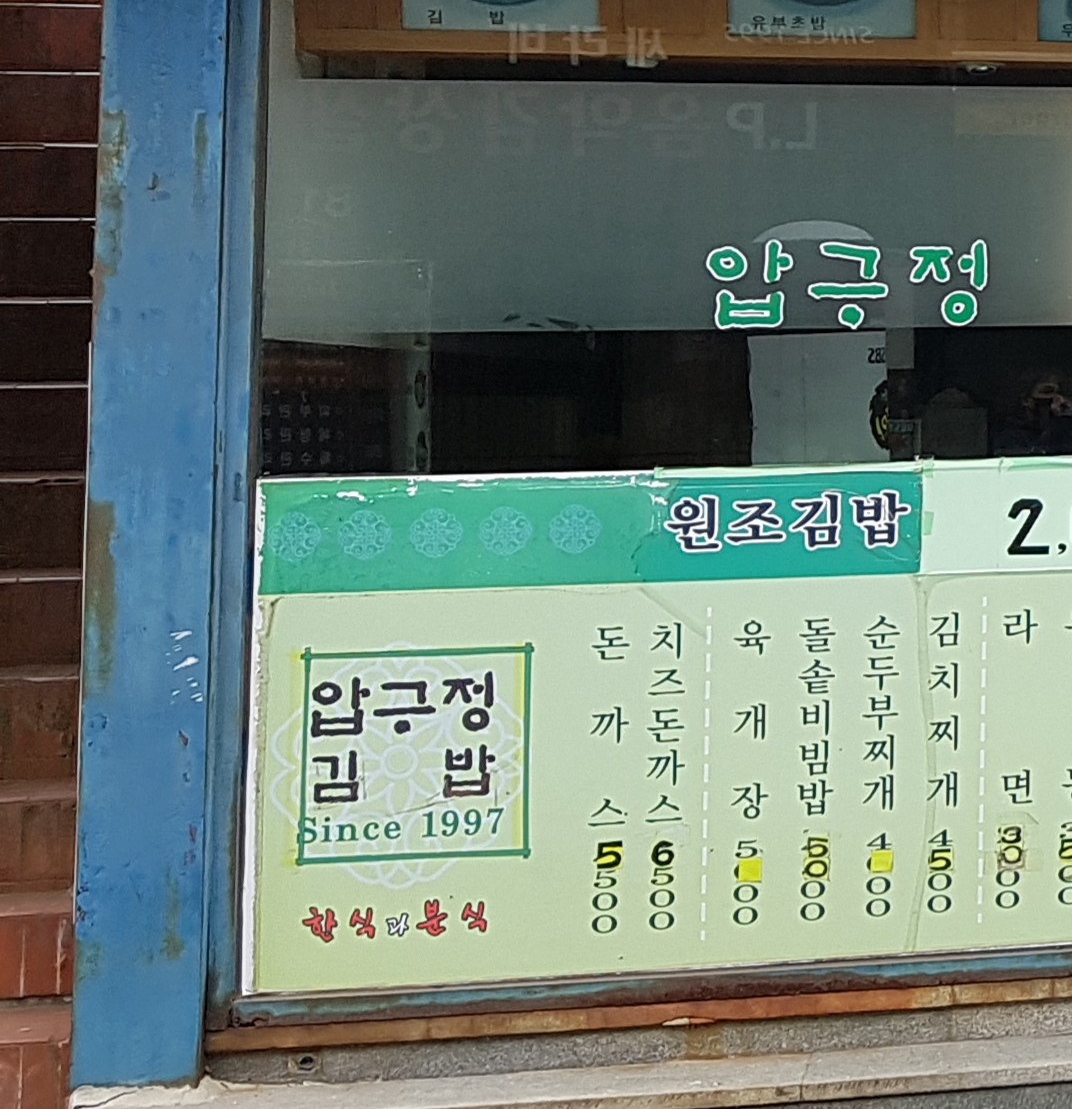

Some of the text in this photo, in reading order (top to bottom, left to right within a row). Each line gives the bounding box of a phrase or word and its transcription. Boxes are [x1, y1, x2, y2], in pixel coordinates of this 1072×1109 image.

[750, 14, 826, 31] 유부초밥
[666, 490, 911, 553] 원조김밥
[644, 622, 686, 930] 치즈돈까스 6500
[798, 617, 837, 817] 돌솥비빔밥
[862, 615, 900, 917] 순두부찌개 400
[926, 611, 960, 913] 김치찌개 4500
[297, 807, 504, 845] Since 1997
[733, 840, 761, 925] 500
